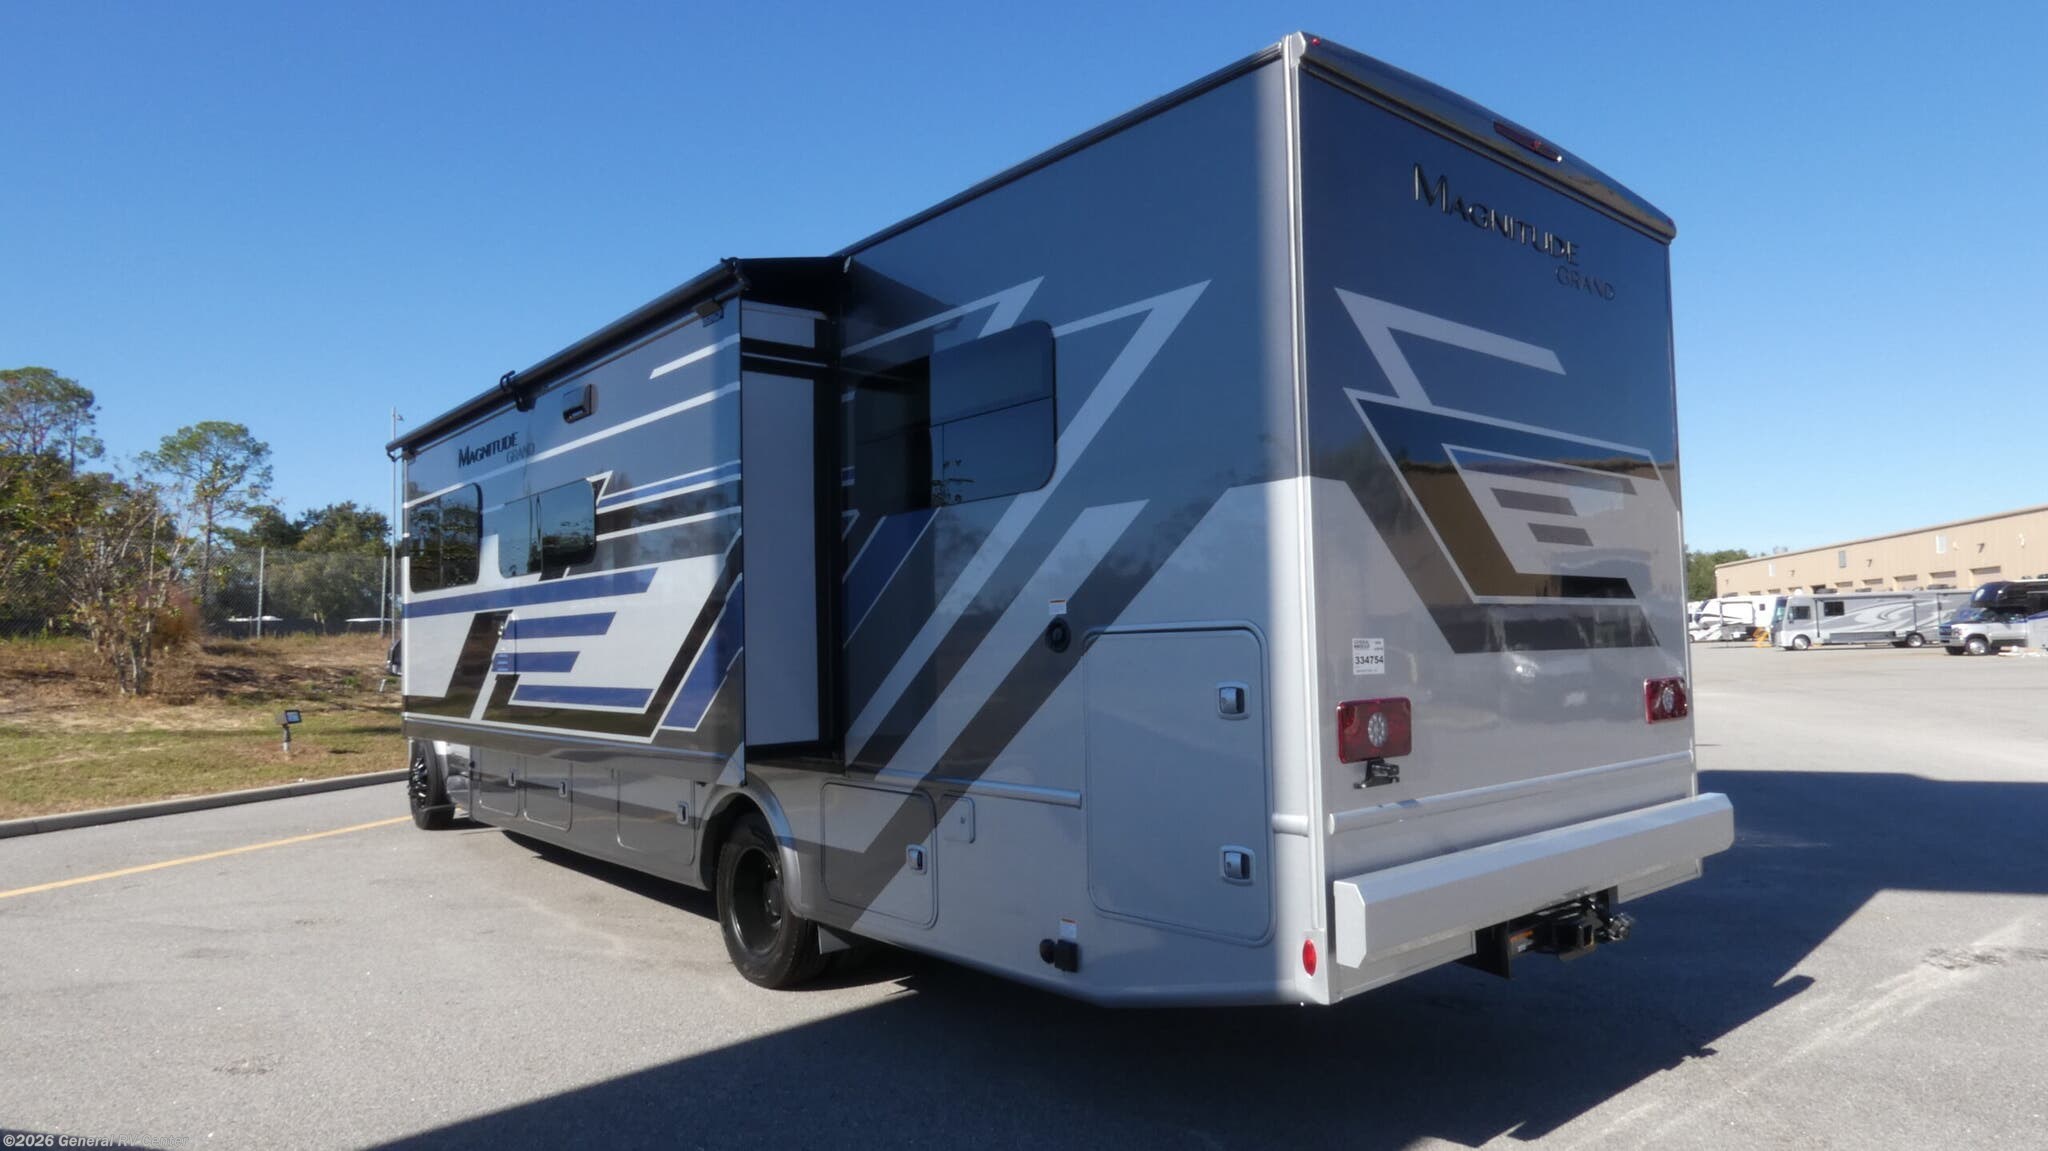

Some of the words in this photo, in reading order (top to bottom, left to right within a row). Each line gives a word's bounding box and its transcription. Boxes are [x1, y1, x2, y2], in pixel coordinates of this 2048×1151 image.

[1411, 162, 1580, 266] MAGNITUDE
[1555, 265, 1616, 301] GRAND
[458, 431, 519, 468] MAGNITUDE
[1354, 655, 1384, 665] 334754
